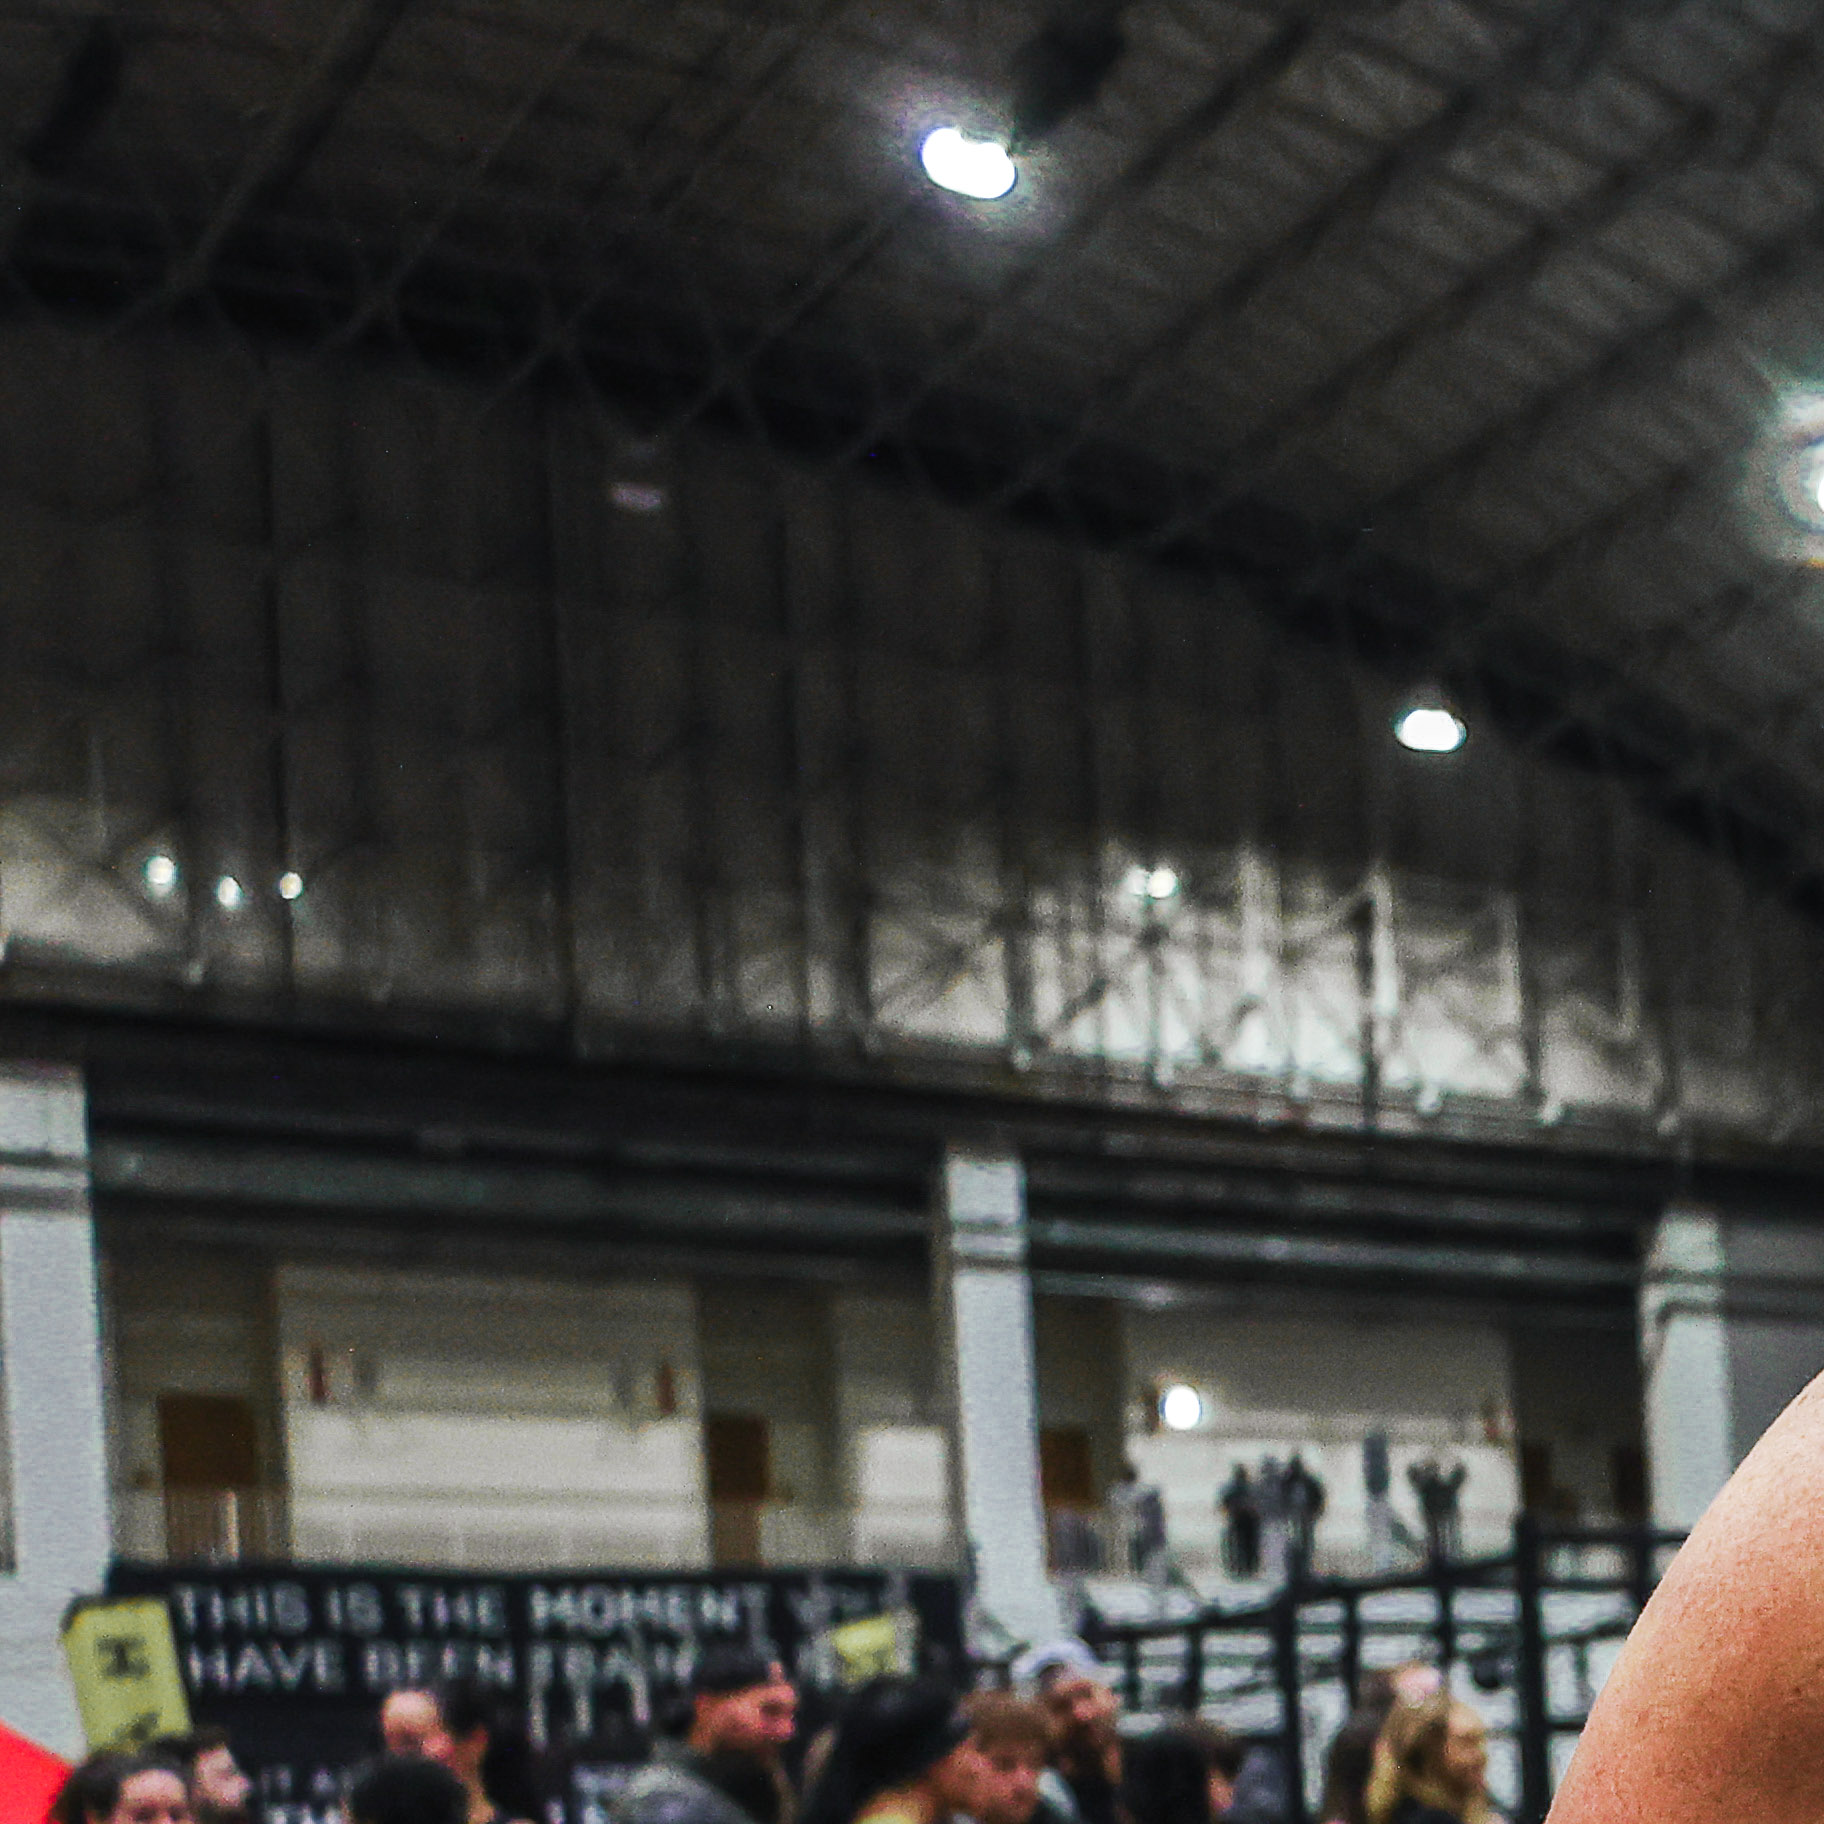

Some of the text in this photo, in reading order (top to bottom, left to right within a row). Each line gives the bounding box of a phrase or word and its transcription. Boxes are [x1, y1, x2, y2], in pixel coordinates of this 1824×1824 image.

[168, 1581, 309, 1635] THIS
[327, 1581, 384, 1635] IS
[396, 1582, 504, 1635] THE
[184, 1640, 345, 1692] HAVE
